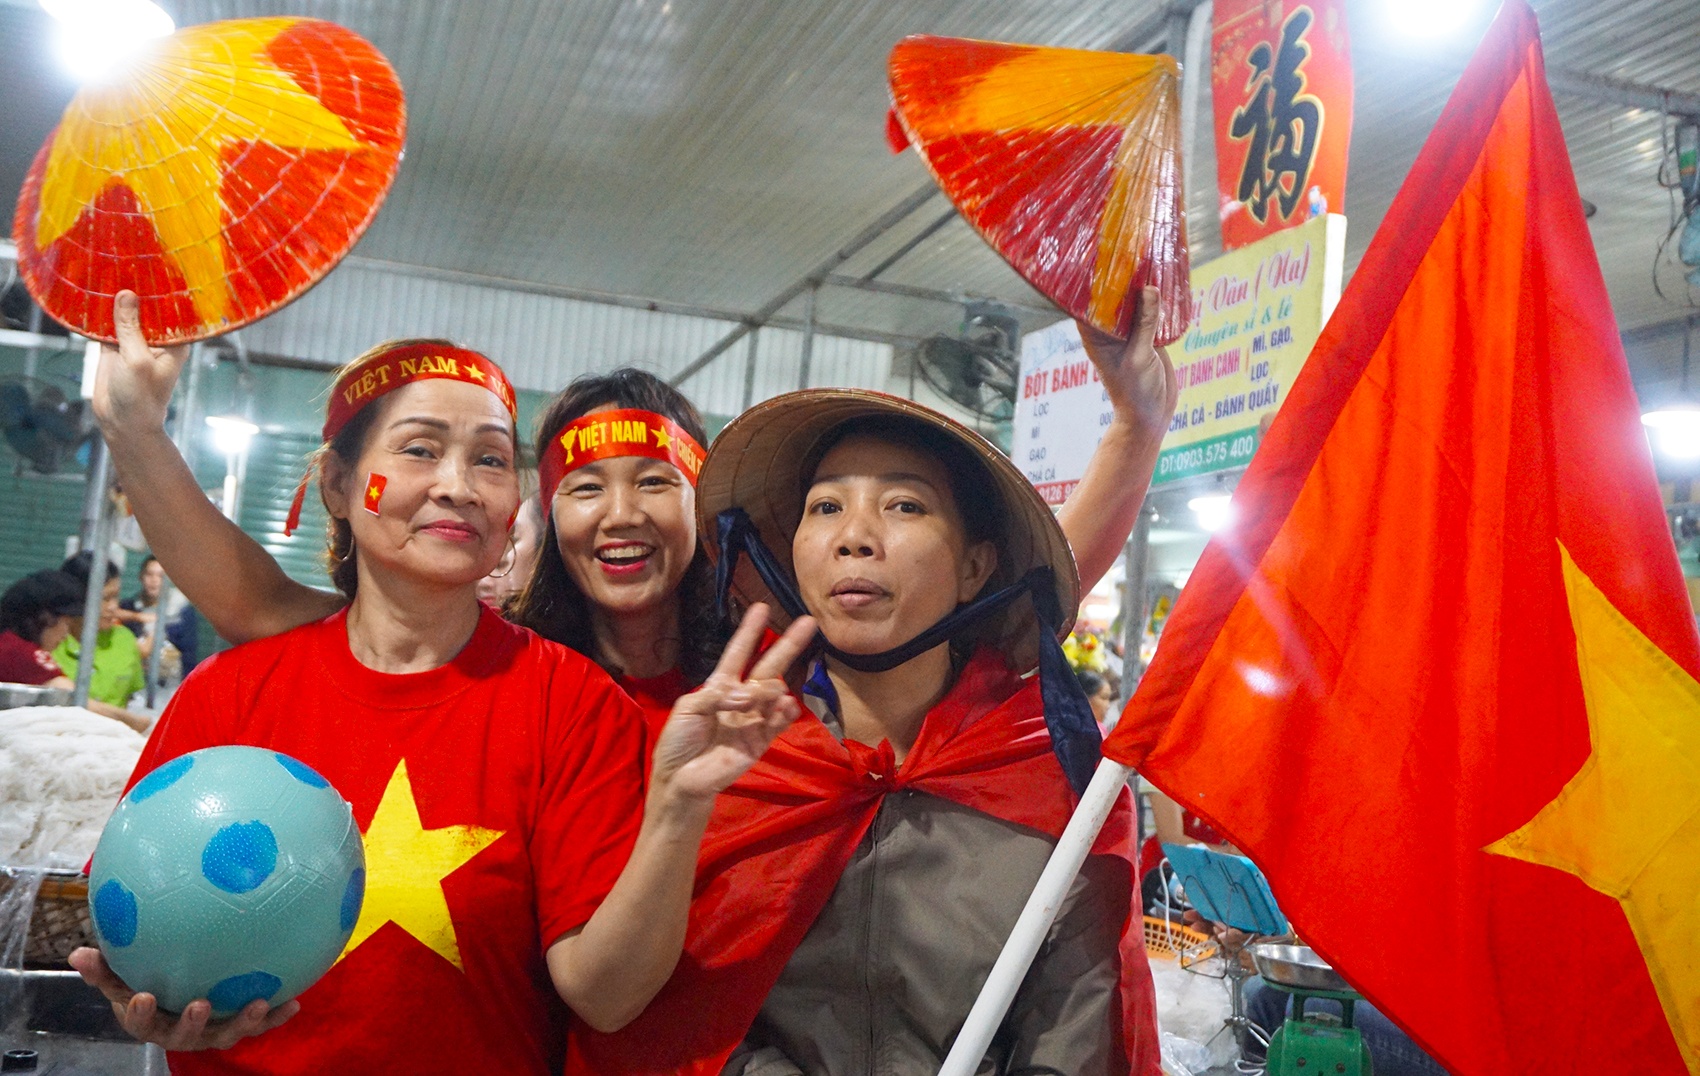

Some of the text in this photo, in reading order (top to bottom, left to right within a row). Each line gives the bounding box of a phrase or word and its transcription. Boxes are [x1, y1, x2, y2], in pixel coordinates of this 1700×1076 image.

[1230, 6, 1323, 224] 福
[1184, 321, 1239, 352] Chuyên
[343, 364, 390, 405] VIỆT
[399, 355, 459, 378] NAM
[1024, 368, 1049, 401] BỘT
[1052, 360, 1089, 392] BÁNH
[1190, 356, 1214, 386] BÁNH
[1216, 347, 1241, 378] CANH
[1250, 361, 1269, 385] LỌC
[1215, 394, 1245, 420] BÁNH
[578, 421, 607, 452] VIỆT
[611, 420, 647, 443] NAM
[1230, 435, 1253, 458] 400
